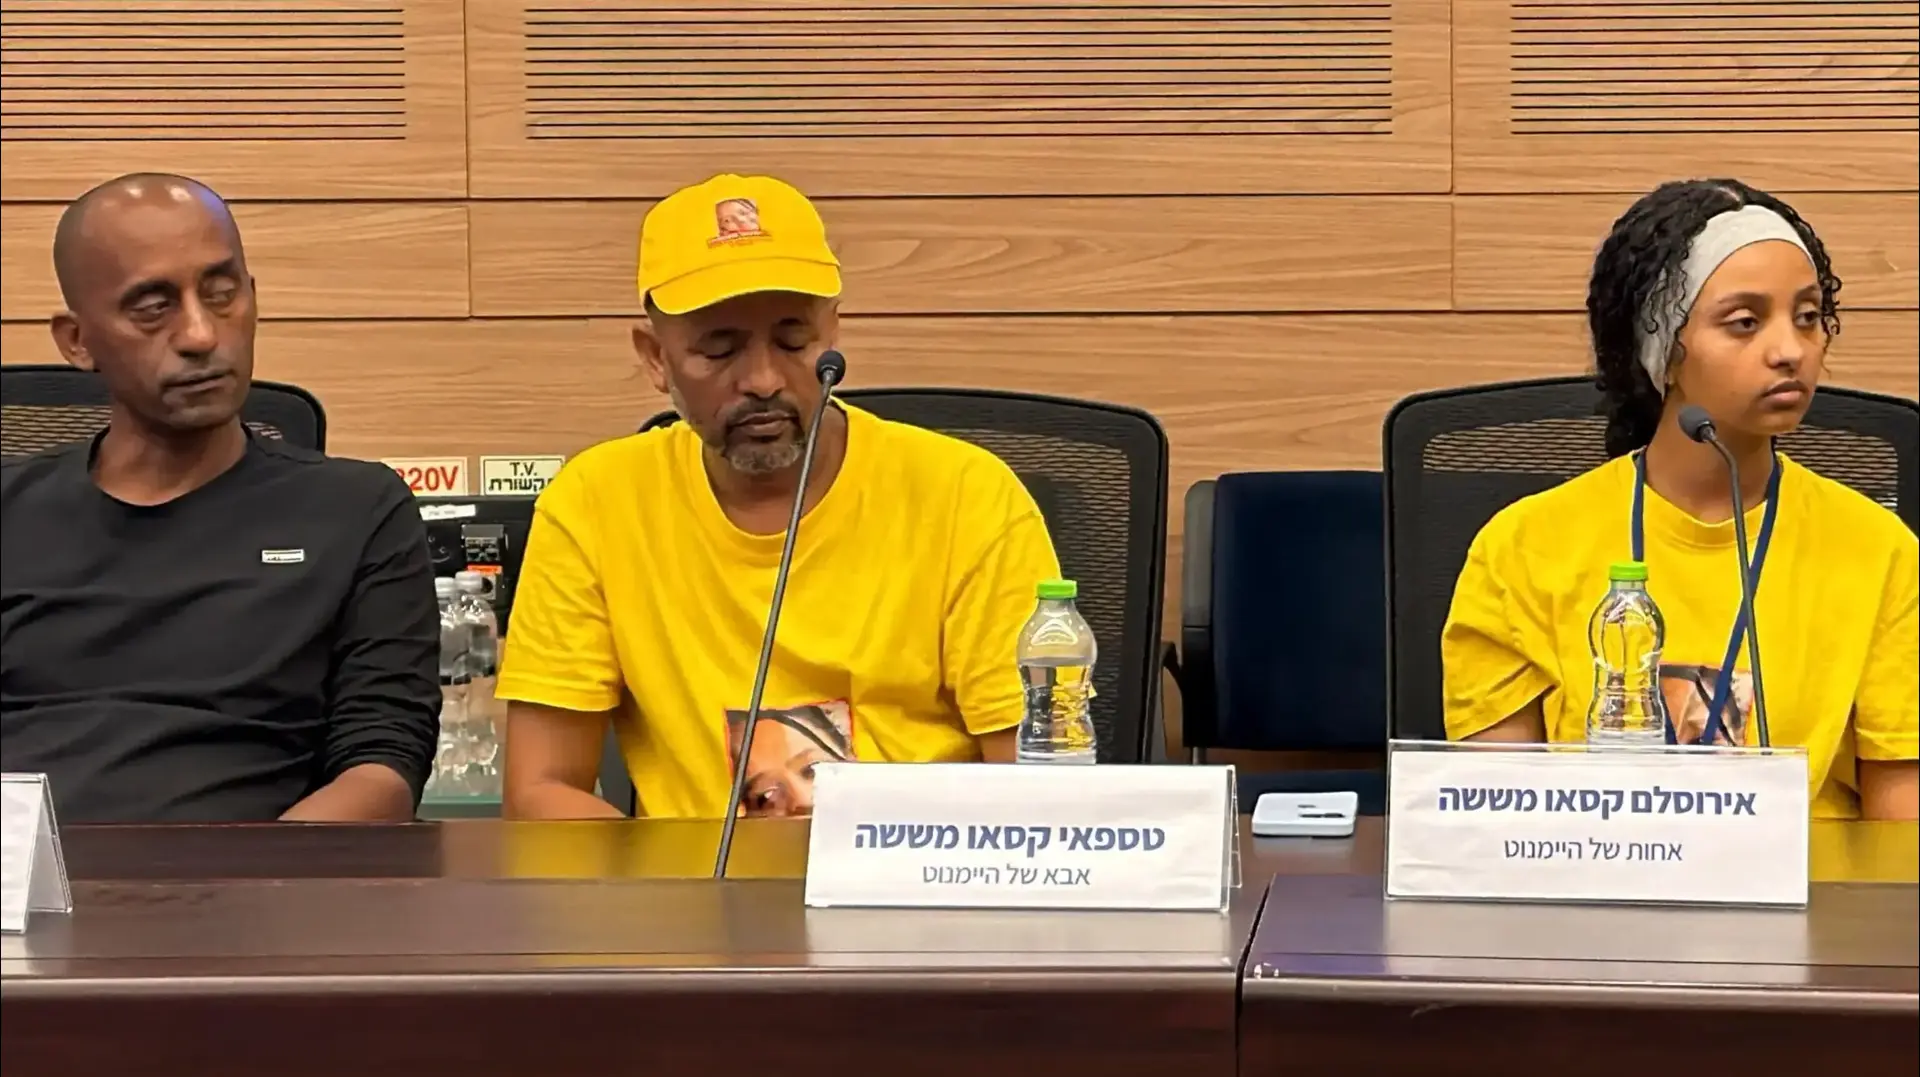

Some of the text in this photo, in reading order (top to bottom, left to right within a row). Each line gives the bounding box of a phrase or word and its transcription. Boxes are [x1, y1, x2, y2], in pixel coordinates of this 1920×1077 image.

[510, 462, 537, 476] T.V.
[1439, 785, 1757, 821] אירוסלם קסאו מששה
[855, 824, 1165, 858] טספאי קסאו מששה
[1504, 838, 1683, 861] אחות של היימנוט
[923, 864, 1090, 886] אבא של היימנוט
